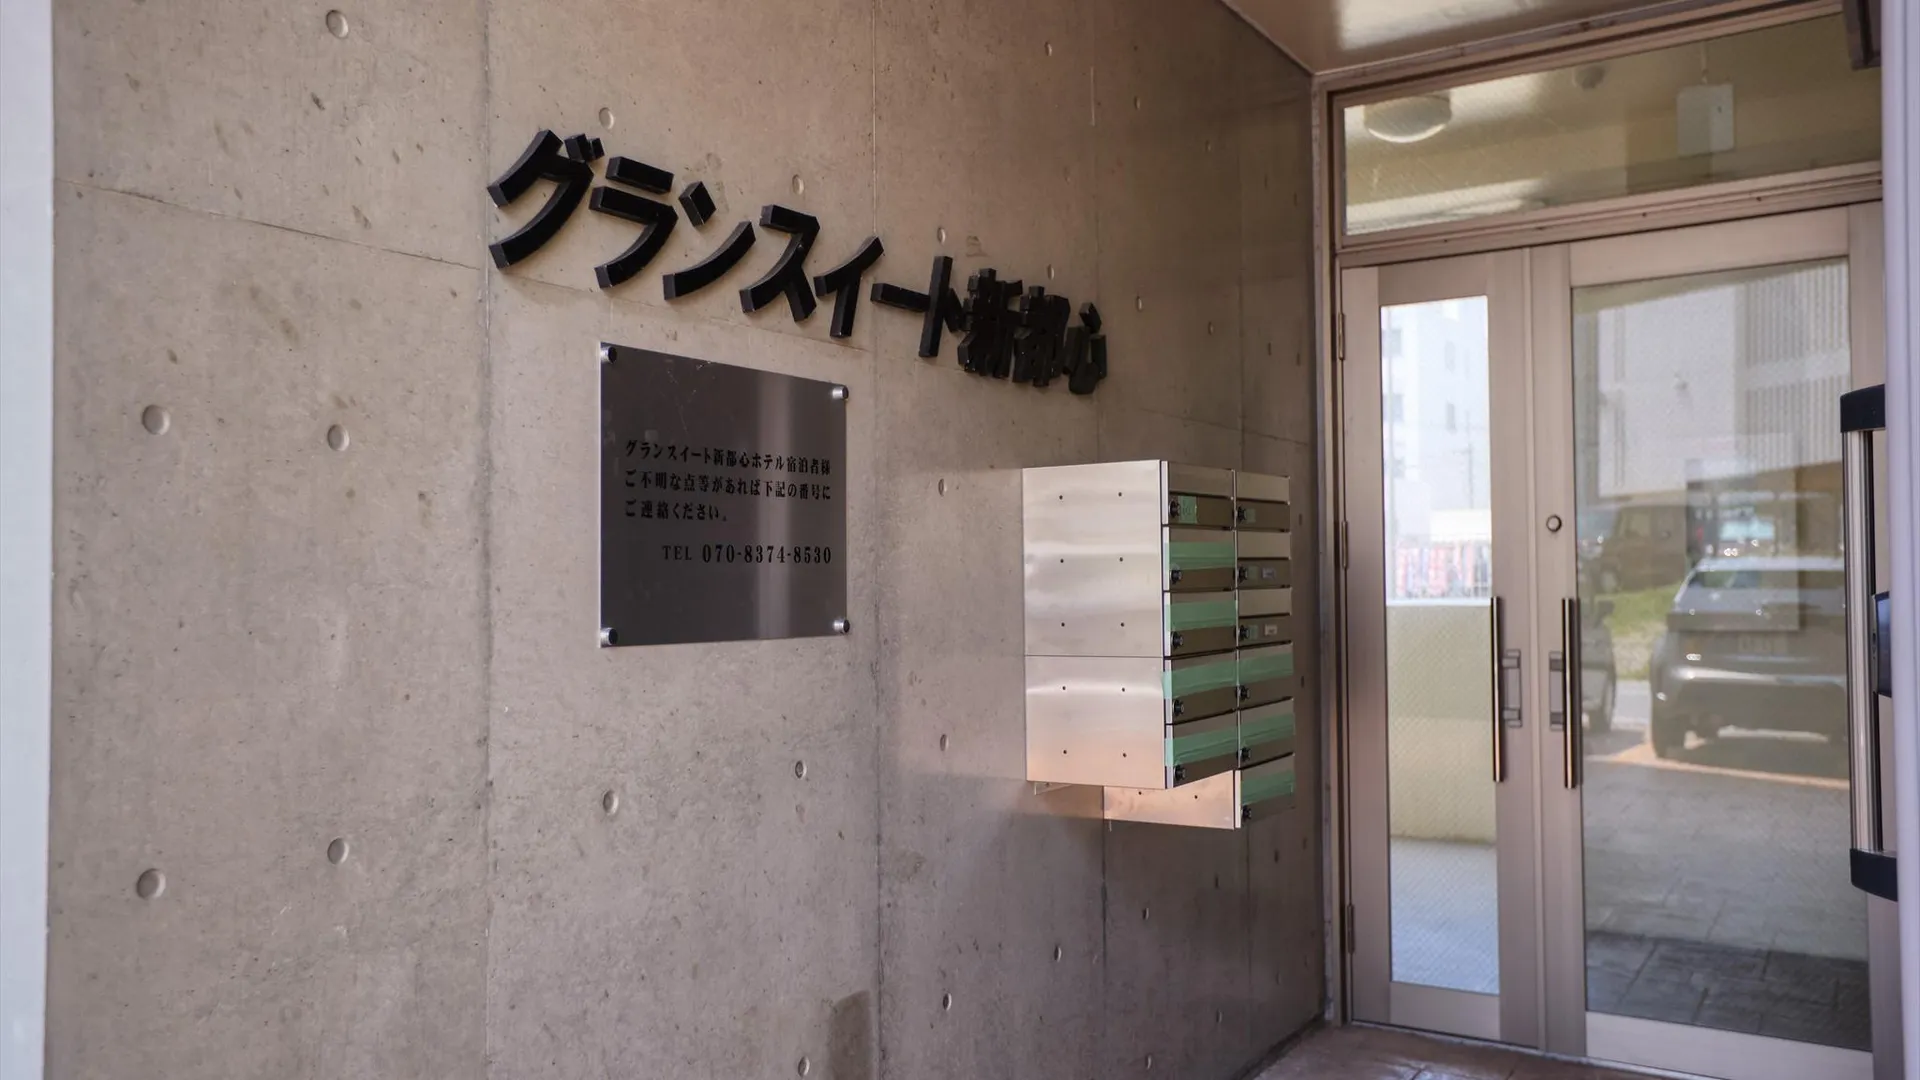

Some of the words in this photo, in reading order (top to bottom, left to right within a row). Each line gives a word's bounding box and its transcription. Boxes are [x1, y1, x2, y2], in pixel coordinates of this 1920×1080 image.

[625, 439, 831, 475] グランスイート新都心ホテル宿泊者様
[625, 469, 831, 500] ご不明な点等があれば下記の番号に
[625, 499, 727, 522] ご連絡ください。
[662, 545, 692, 561] TEL
[702, 544, 832, 564] 070-8374-8530
